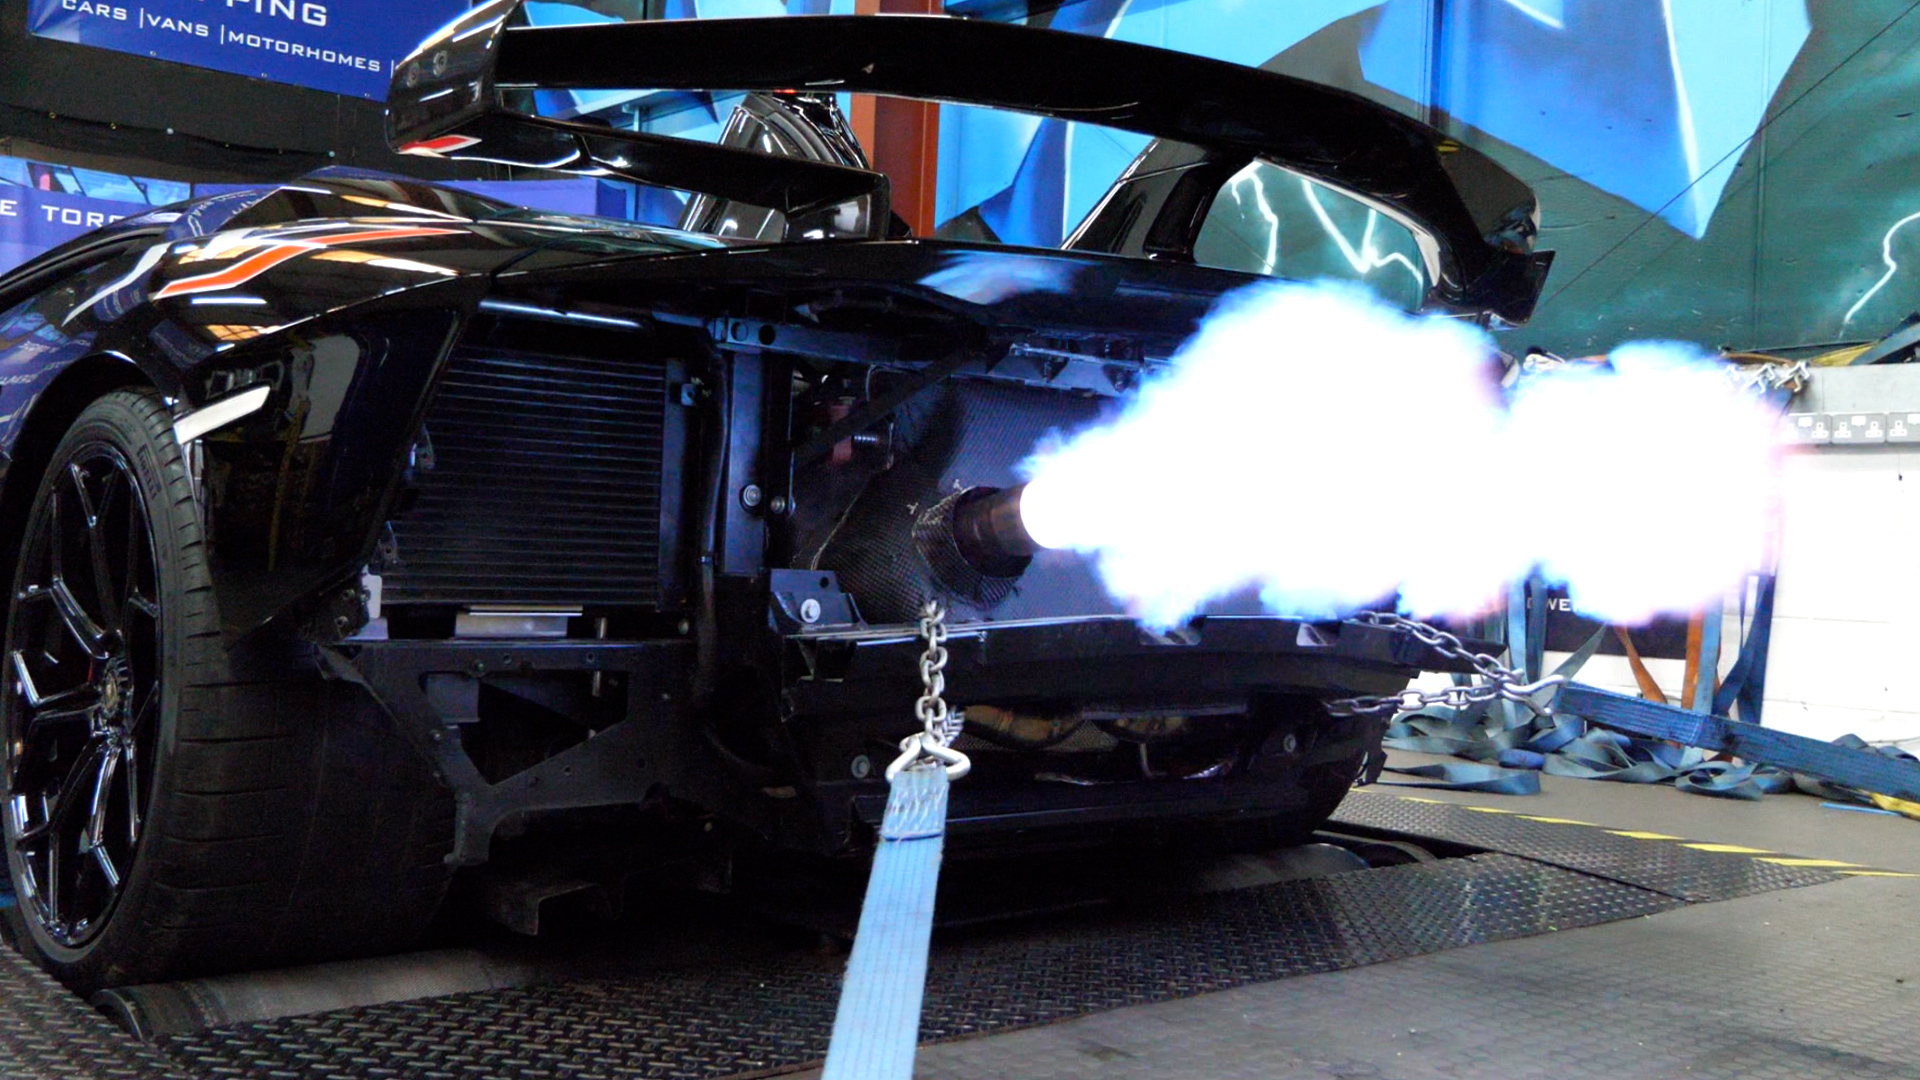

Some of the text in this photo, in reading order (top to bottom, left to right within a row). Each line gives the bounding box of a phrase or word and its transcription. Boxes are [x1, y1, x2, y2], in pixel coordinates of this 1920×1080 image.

[62, 0, 127, 21] CARS
[228, 30, 380, 72] MOTORHOMES
[41, 205, 125, 227] TOR
